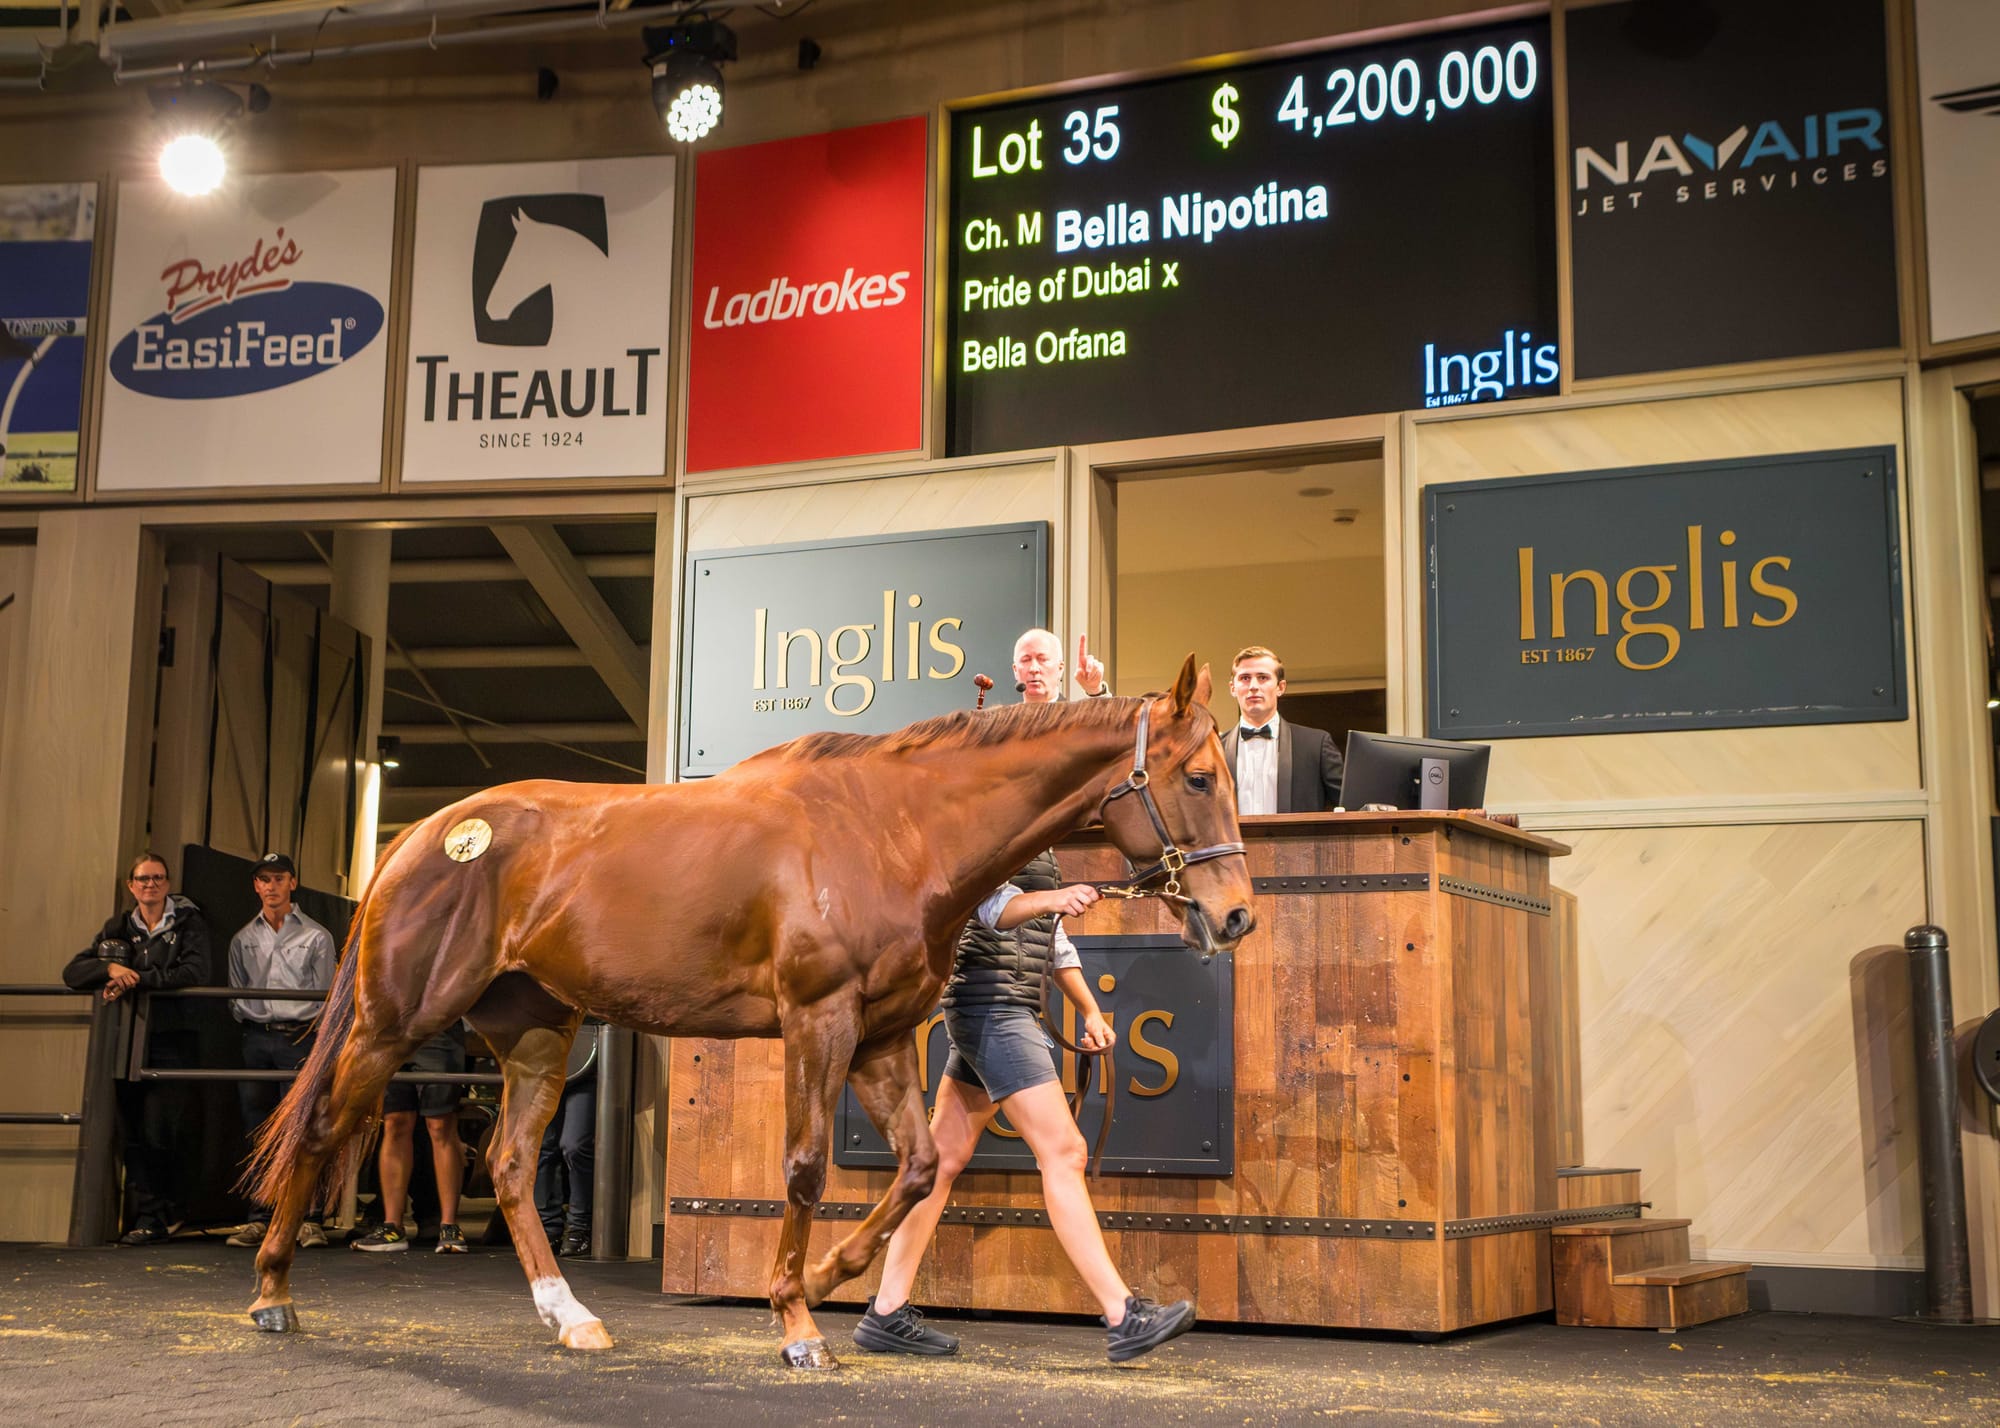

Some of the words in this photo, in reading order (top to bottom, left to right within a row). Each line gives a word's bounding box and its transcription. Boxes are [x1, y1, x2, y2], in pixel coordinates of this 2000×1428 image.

[972, 118, 1043, 179] Lot
[1063, 105, 1121, 165] 35
[1210, 82, 1241, 149] $
[1277, 40, 1538, 138] 4,200,000
[1575, 107, 1885, 190] NAVAIR
[964, 218, 1009, 253] Ch.
[1017, 211, 1042, 246] M
[1056, 202, 1150, 253] Bella
[1162, 181, 1330, 244] Nipotina
[1577, 192, 1643, 217] JET
[1676, 160, 1888, 203] SERVICES
[160, 226, 303, 312] Pryde's
[703, 267, 911, 330] Ladbrokes
[963, 274, 1032, 313] Pride
[1039, 268, 1067, 303] of
[1072, 257, 1151, 299] Dubai
[1161, 261, 1180, 289] x
[963, 335, 1028, 373] Bella
[1034, 327, 1127, 364] Orfana
[1424, 330, 1560, 401] Inglis
[479, 432, 532, 449] SINCE
[542, 431, 584, 446] 1924
[1518, 524, 1799, 671] Inglis
[753, 589, 966, 716] Inglis
[1520, 649, 1550, 664] EST
[1555, 647, 1596, 663] 1867
[753, 698, 776, 712] EST
[780, 696, 812, 711] 1867
